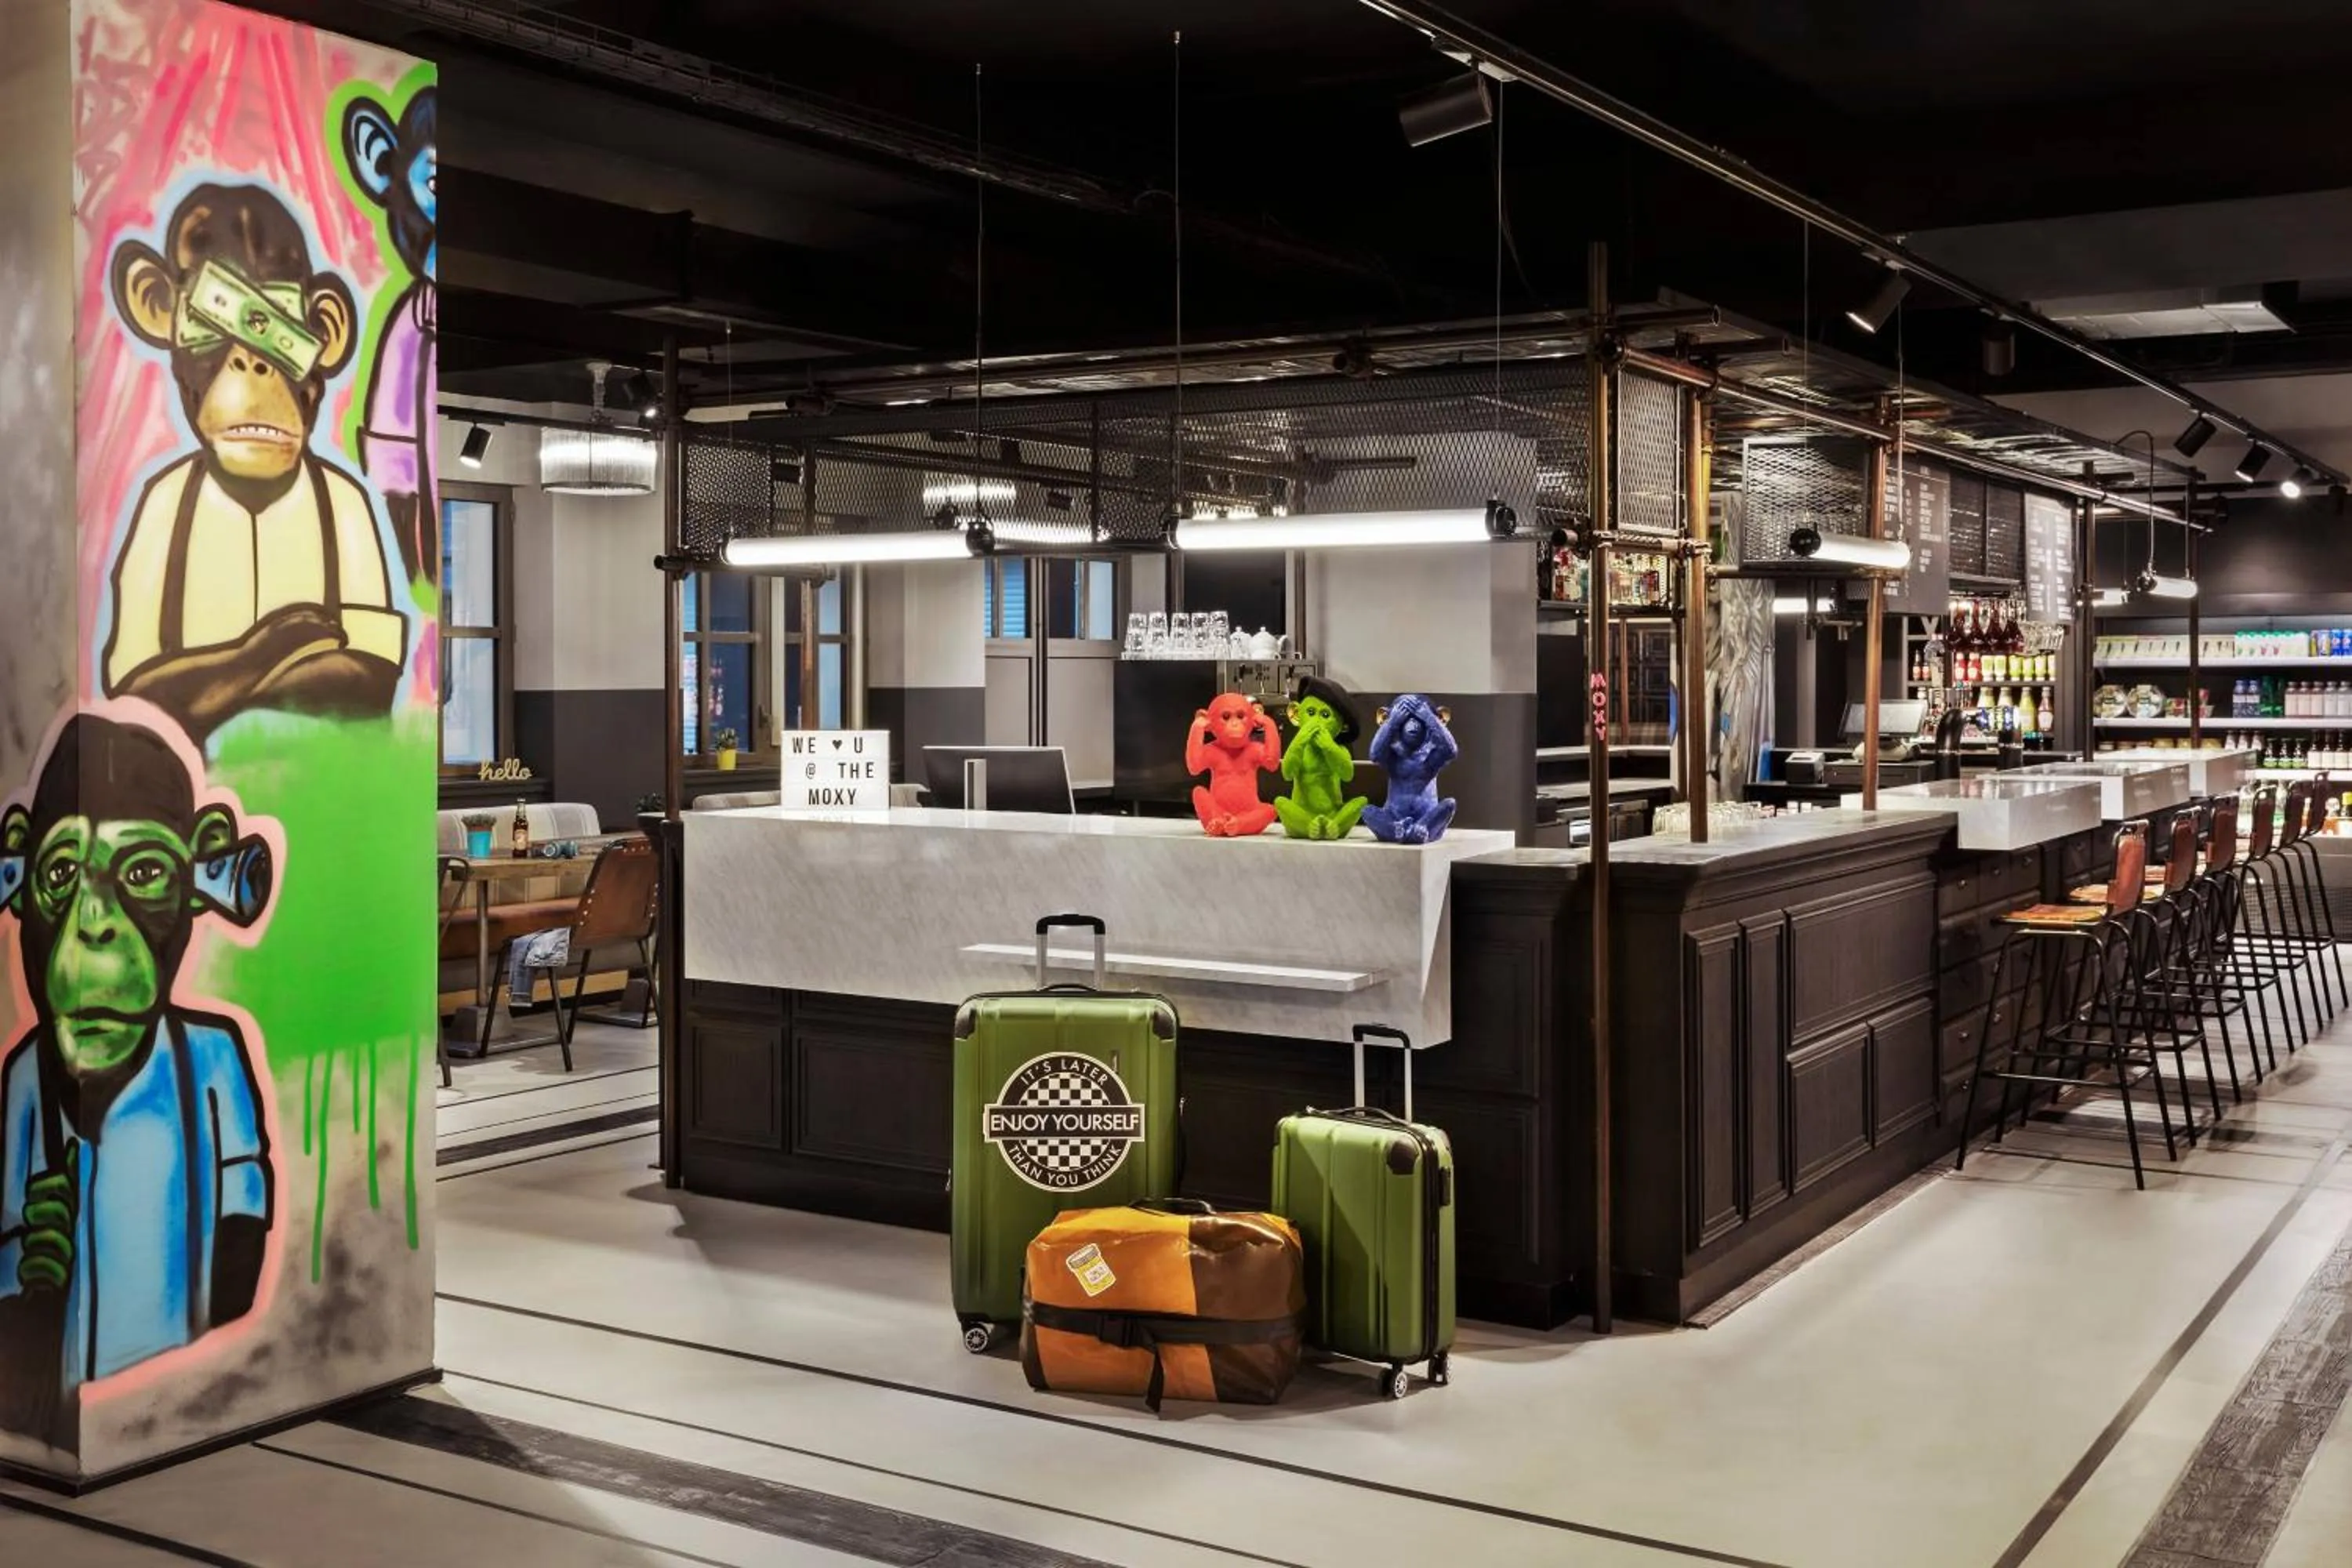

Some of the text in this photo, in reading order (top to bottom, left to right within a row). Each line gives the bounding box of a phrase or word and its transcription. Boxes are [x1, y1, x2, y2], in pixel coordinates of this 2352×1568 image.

[1591, 673, 1606, 741] MOXY
[793, 737, 863, 753] WE U
[477, 757, 532, 780] hello
[805, 762, 874, 779] @ THE
[808, 788, 856, 805] MOXY
[1020, 1058, 1109, 1087] IT'S LATER
[990, 1114, 1138, 1131] ENJOY YOURSELF
[1007, 1144, 1122, 1187] THAN YOU THINK
